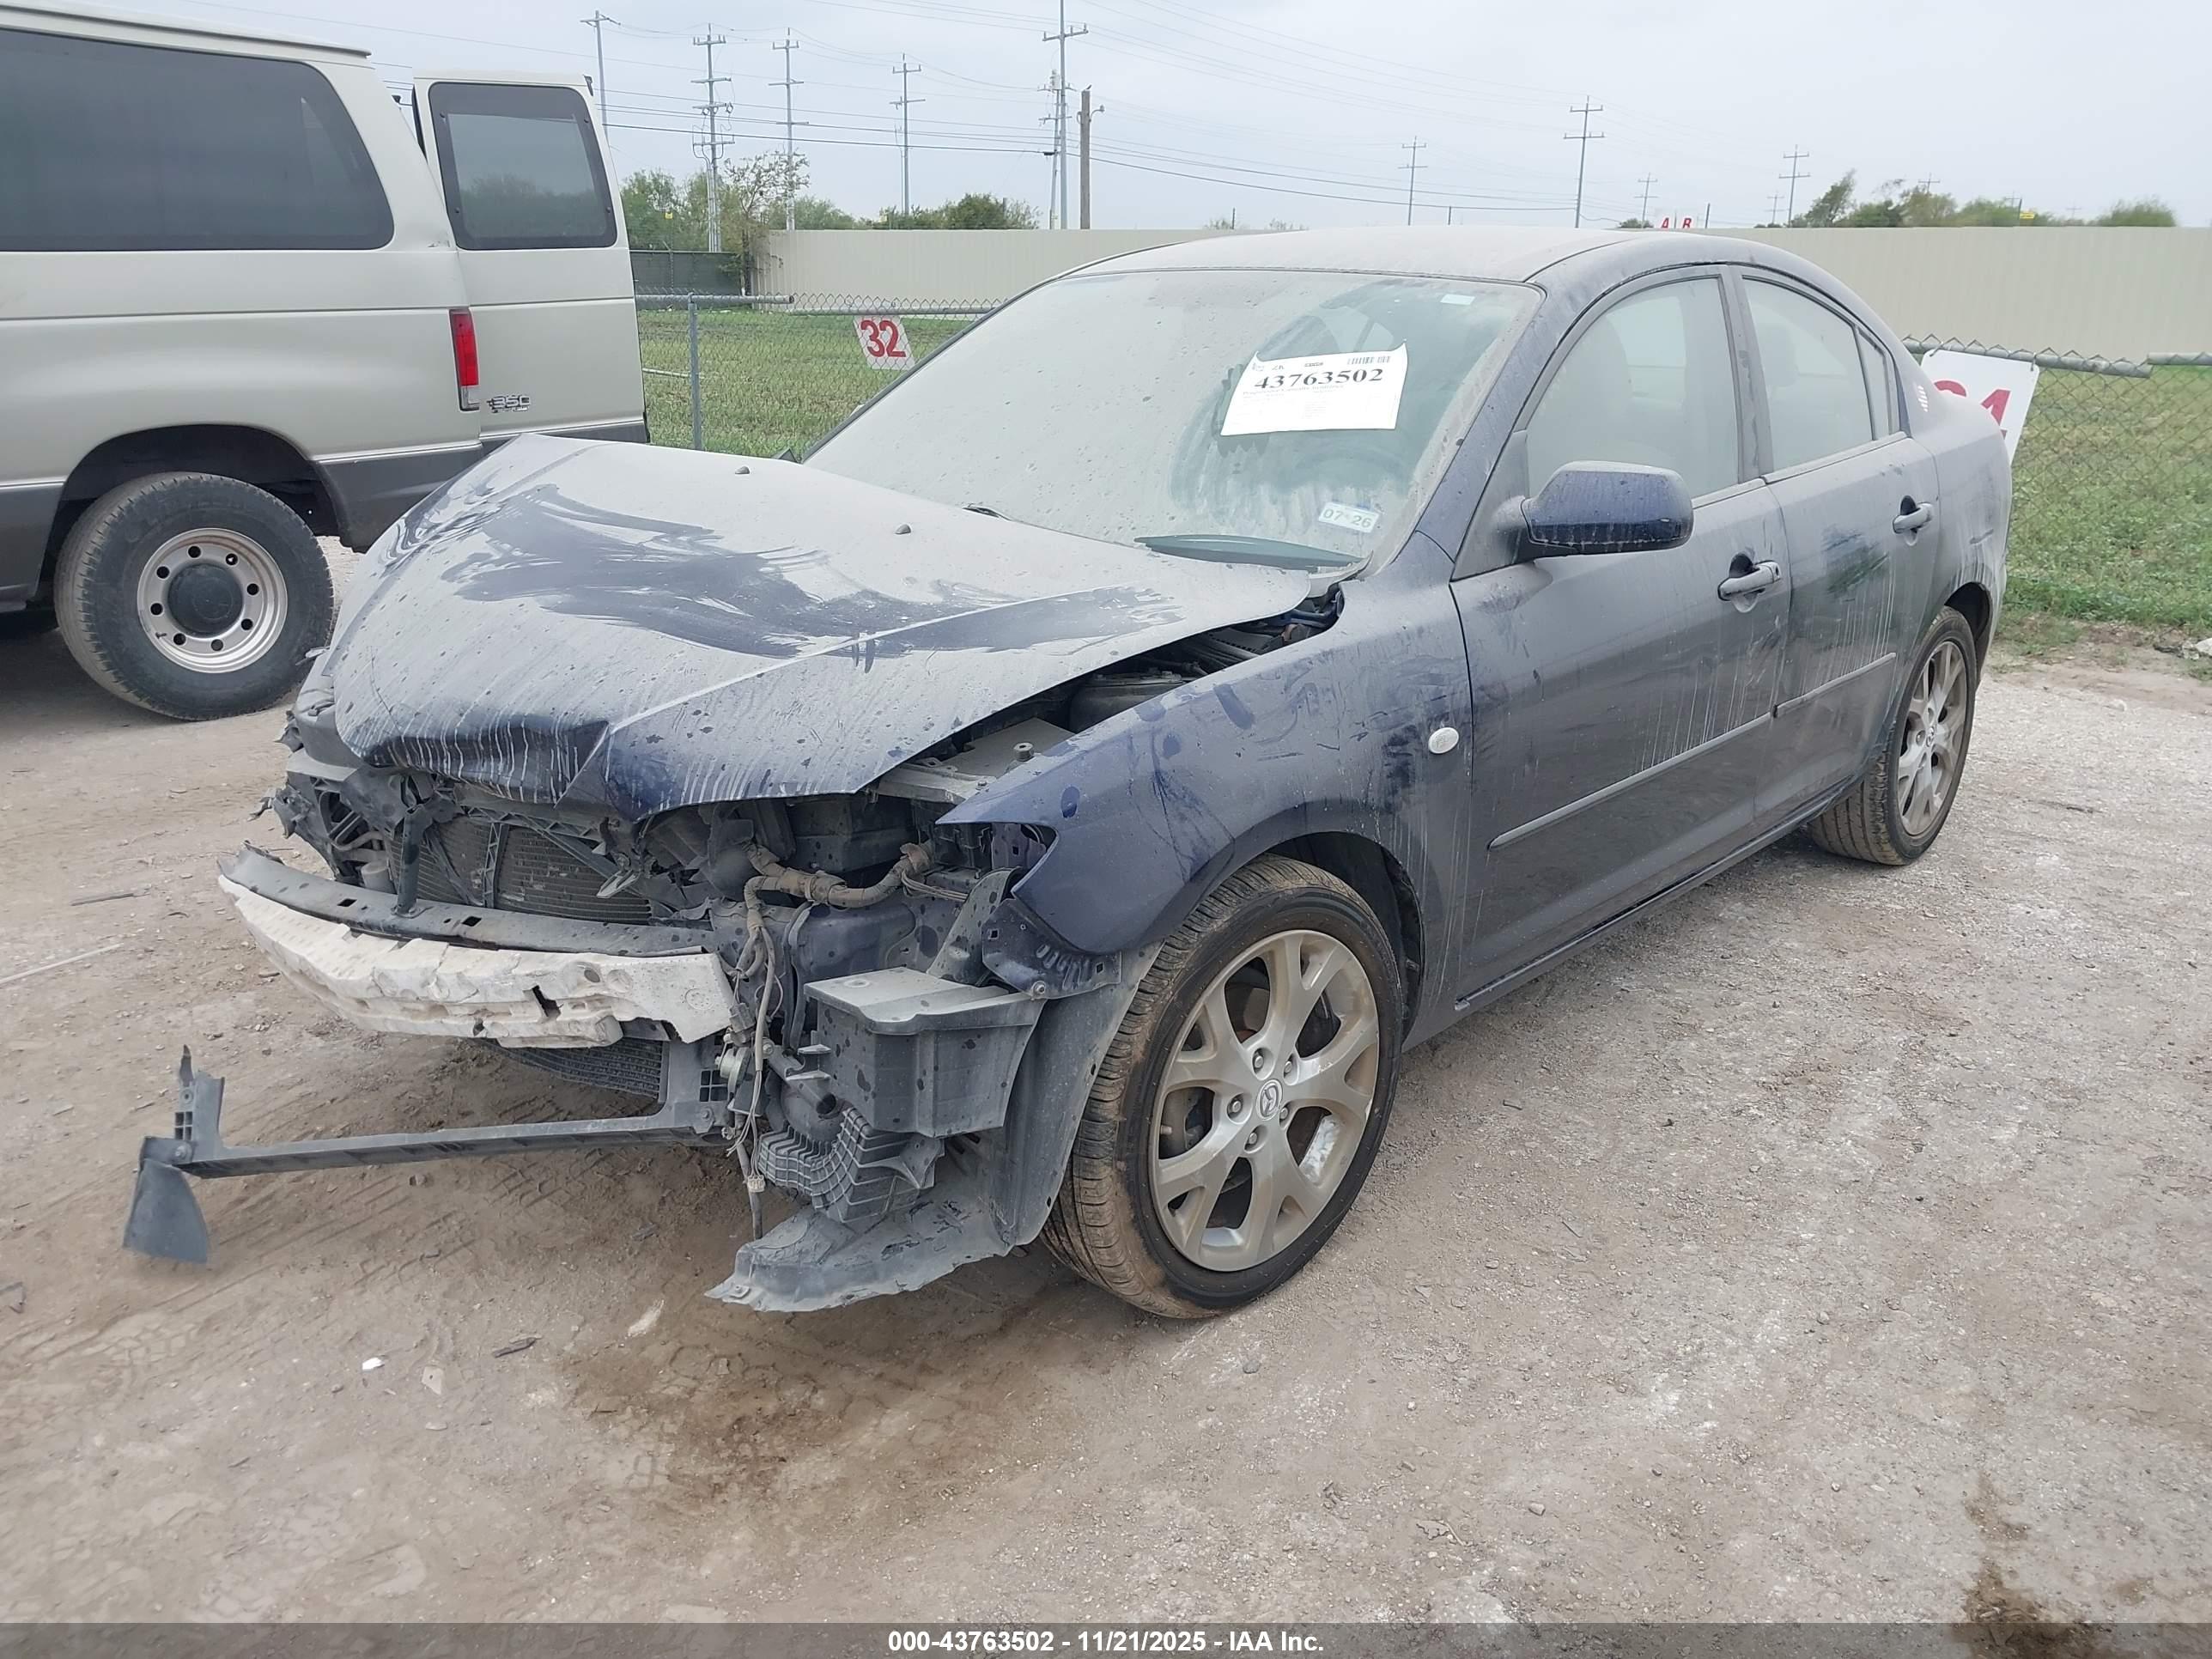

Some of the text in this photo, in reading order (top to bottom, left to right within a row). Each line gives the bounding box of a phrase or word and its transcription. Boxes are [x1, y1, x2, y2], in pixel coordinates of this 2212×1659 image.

[1661, 217, 1669, 228] A
[860, 319, 907, 357] 32
[1254, 368, 1383, 389] 43763502
[1322, 508, 1373, 528] 07 26
